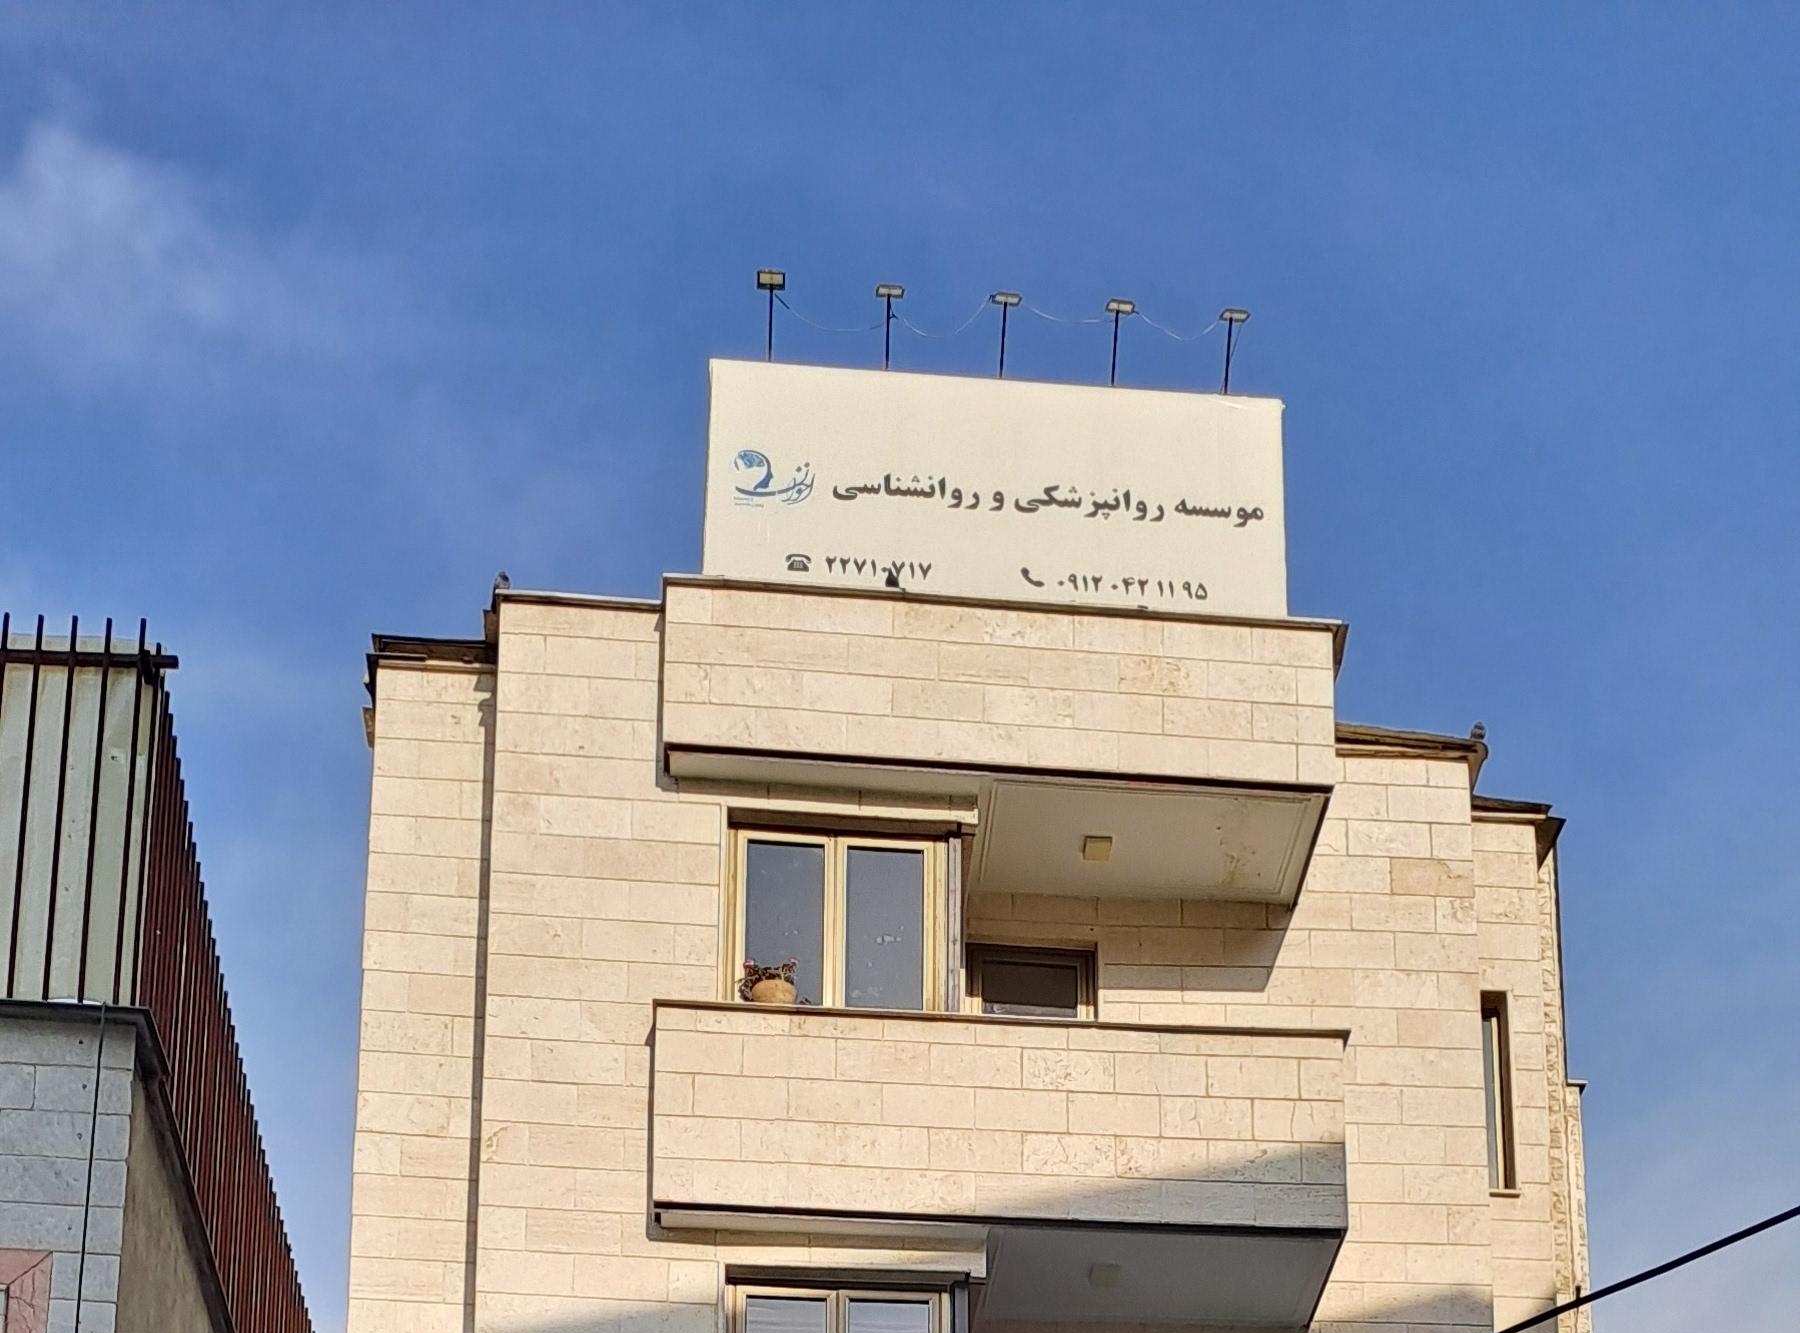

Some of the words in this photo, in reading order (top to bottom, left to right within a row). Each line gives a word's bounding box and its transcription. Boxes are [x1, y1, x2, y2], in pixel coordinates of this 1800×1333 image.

[832, 473, 980, 510] روانشناسی
[989, 493, 1004, 511] و
[1014, 485, 1164, 522] روانپزشکی
[1174, 498, 1264, 527] موسسه
[825, 556, 932, 580] ۲۲۷۱۰۷۱۷
